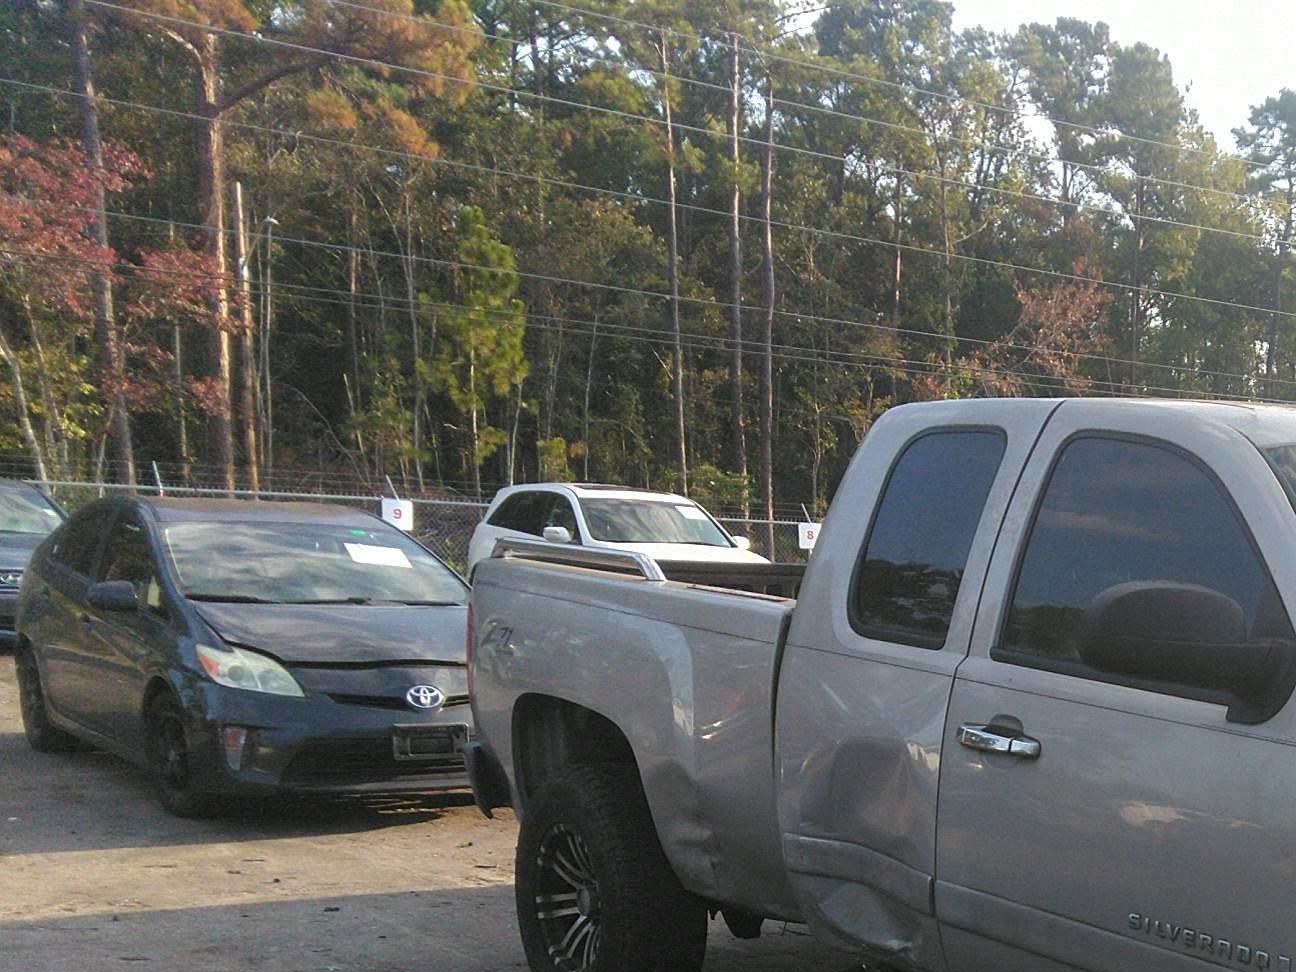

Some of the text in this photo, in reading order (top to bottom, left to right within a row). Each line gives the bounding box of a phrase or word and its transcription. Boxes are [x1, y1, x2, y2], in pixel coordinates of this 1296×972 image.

[393, 508, 402, 519] 9
[807, 530, 815, 540] 8
[1127, 912, 1270, 972] SILVERADO
